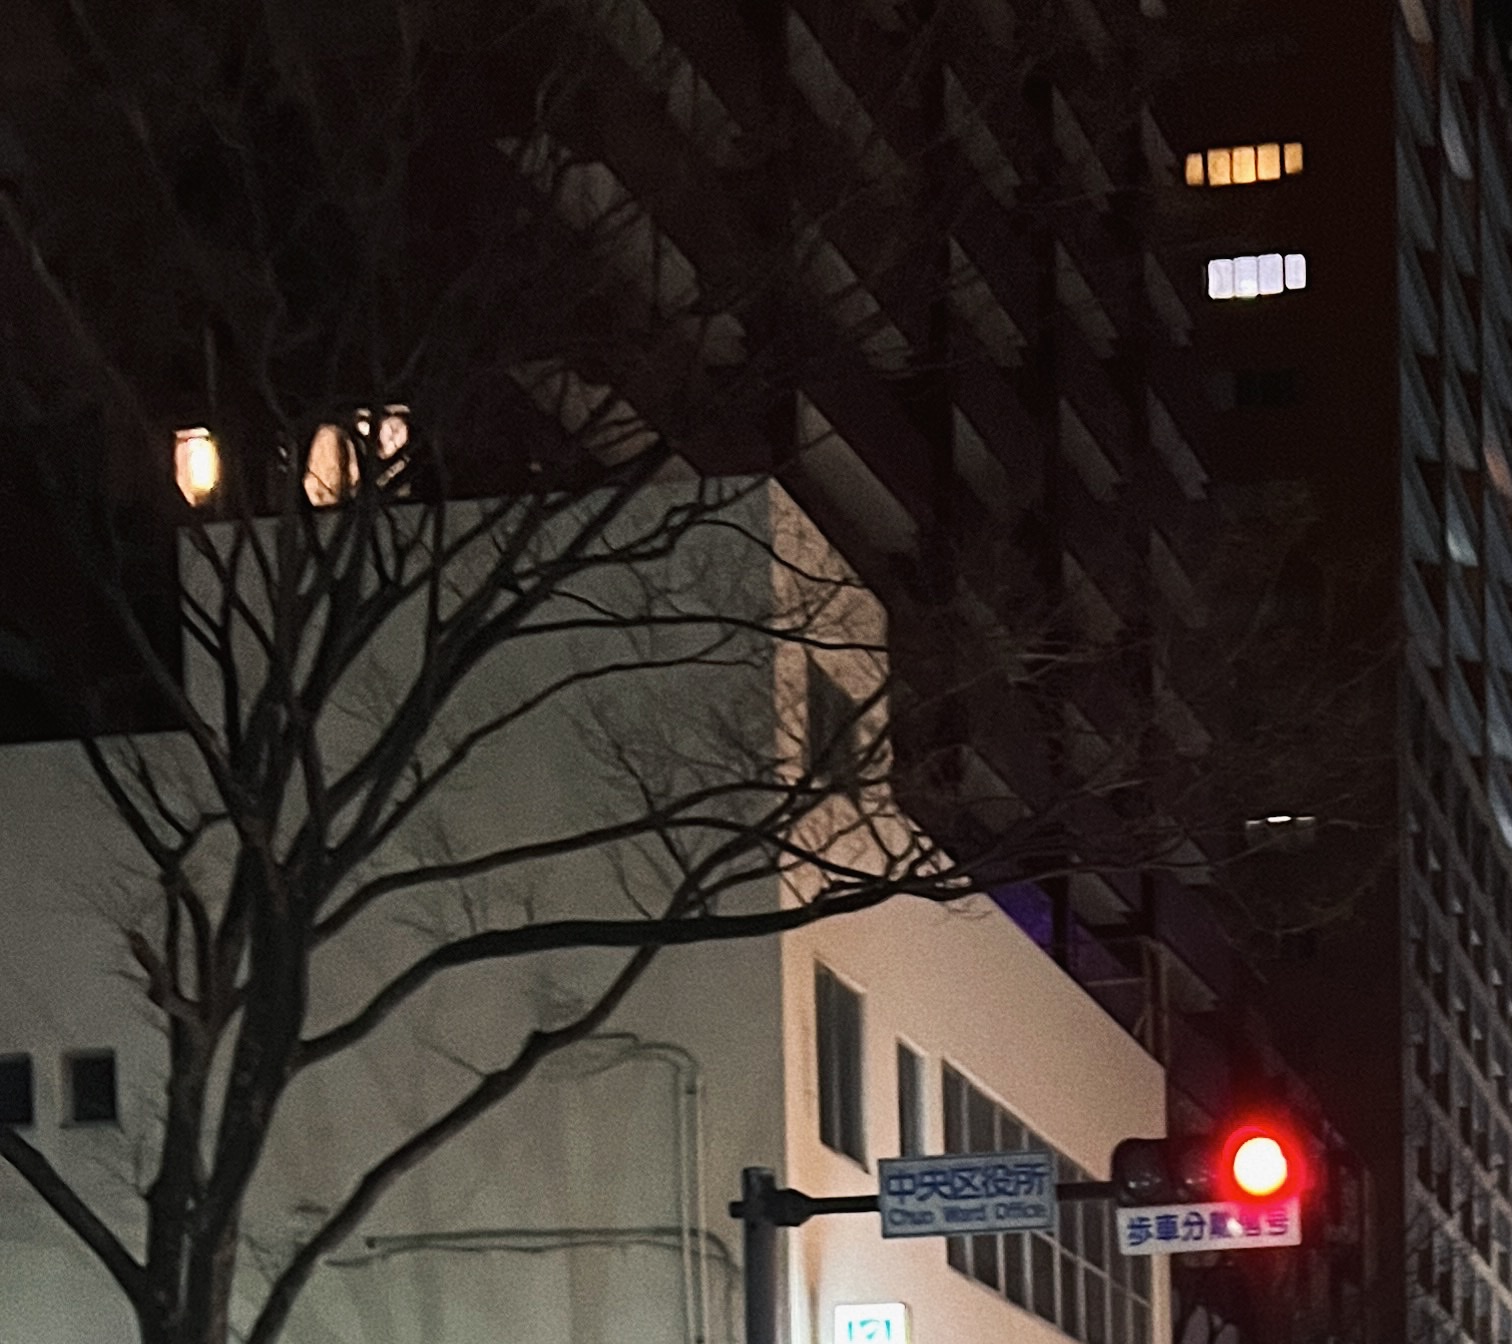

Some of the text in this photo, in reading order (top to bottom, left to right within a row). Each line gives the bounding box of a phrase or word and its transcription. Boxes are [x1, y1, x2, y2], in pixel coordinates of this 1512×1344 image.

[887, 1162, 1049, 1205] 中央区役所
[995, 1201, 1047, 1219] Office
